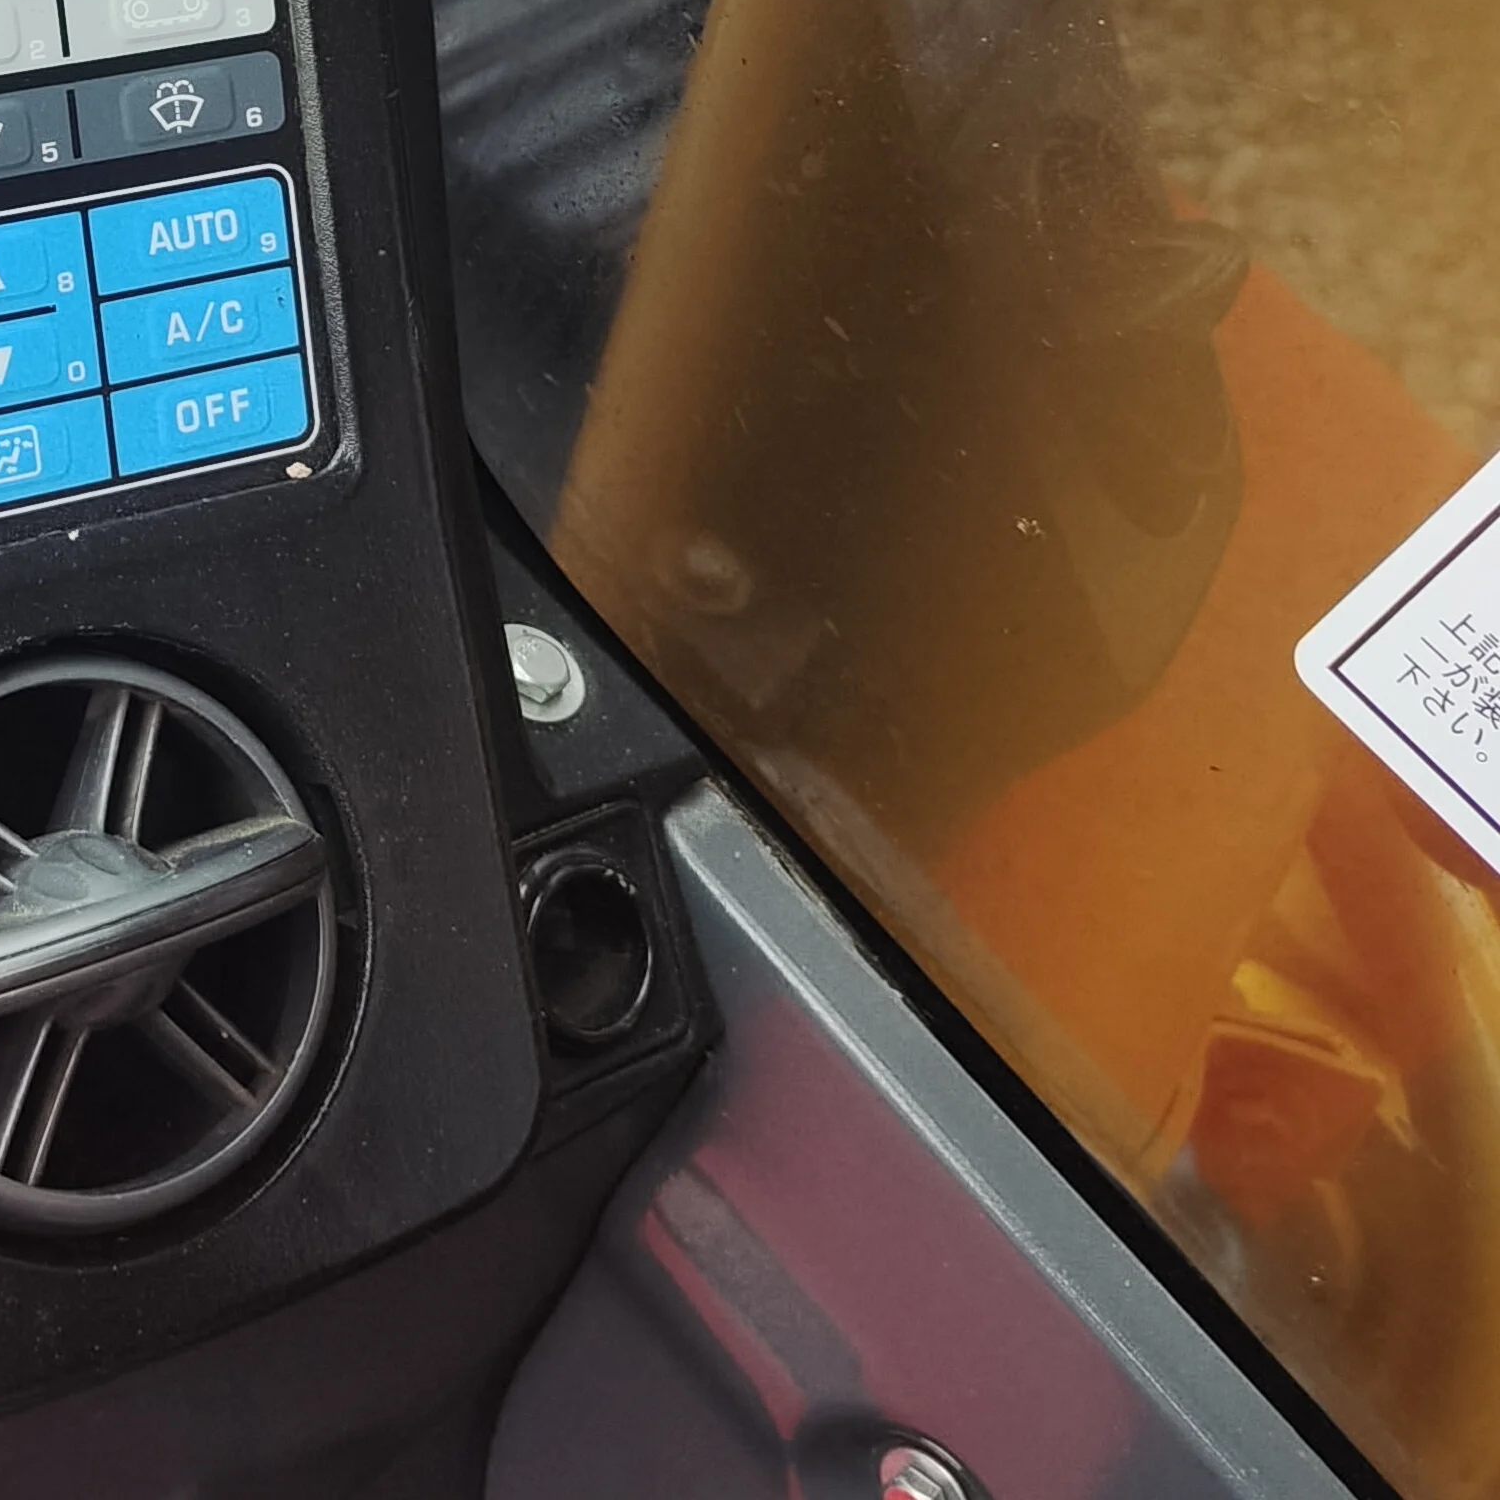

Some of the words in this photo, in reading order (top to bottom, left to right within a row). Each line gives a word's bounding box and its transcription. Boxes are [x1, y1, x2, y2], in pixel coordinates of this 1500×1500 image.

[236, 7, 252, 28] 3
[29, 40, 46, 60] 2
[246, 106, 263, 128] 6
[41, 142, 59, 163] 5
[148, 208, 239, 256] AUTO
[260, 232, 277, 254] 9
[57, 271, 74, 294] 8
[166, 299, 244, 347] A/C
[176, 387, 251, 434] OFF
[1396, 653, 1488, 763] 下さい。
